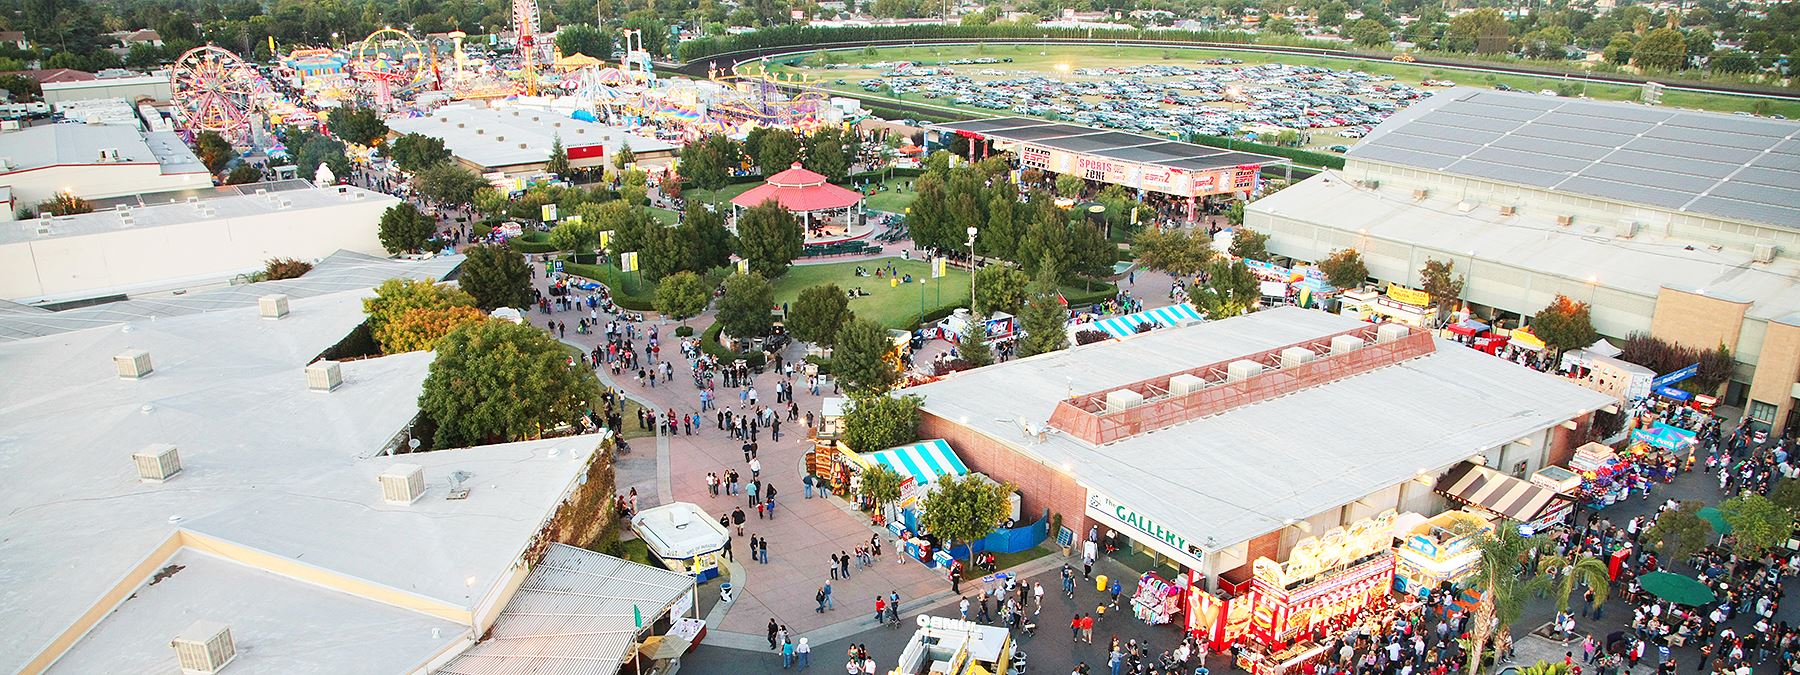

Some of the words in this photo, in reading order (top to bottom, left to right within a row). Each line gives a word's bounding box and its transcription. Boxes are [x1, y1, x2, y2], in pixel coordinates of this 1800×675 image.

[1079, 158, 1112, 173] SPORTS
[1085, 169, 1105, 181] ZONE
[1105, 498, 1116, 508] The
[1115, 505, 1185, 550] GALLERY
